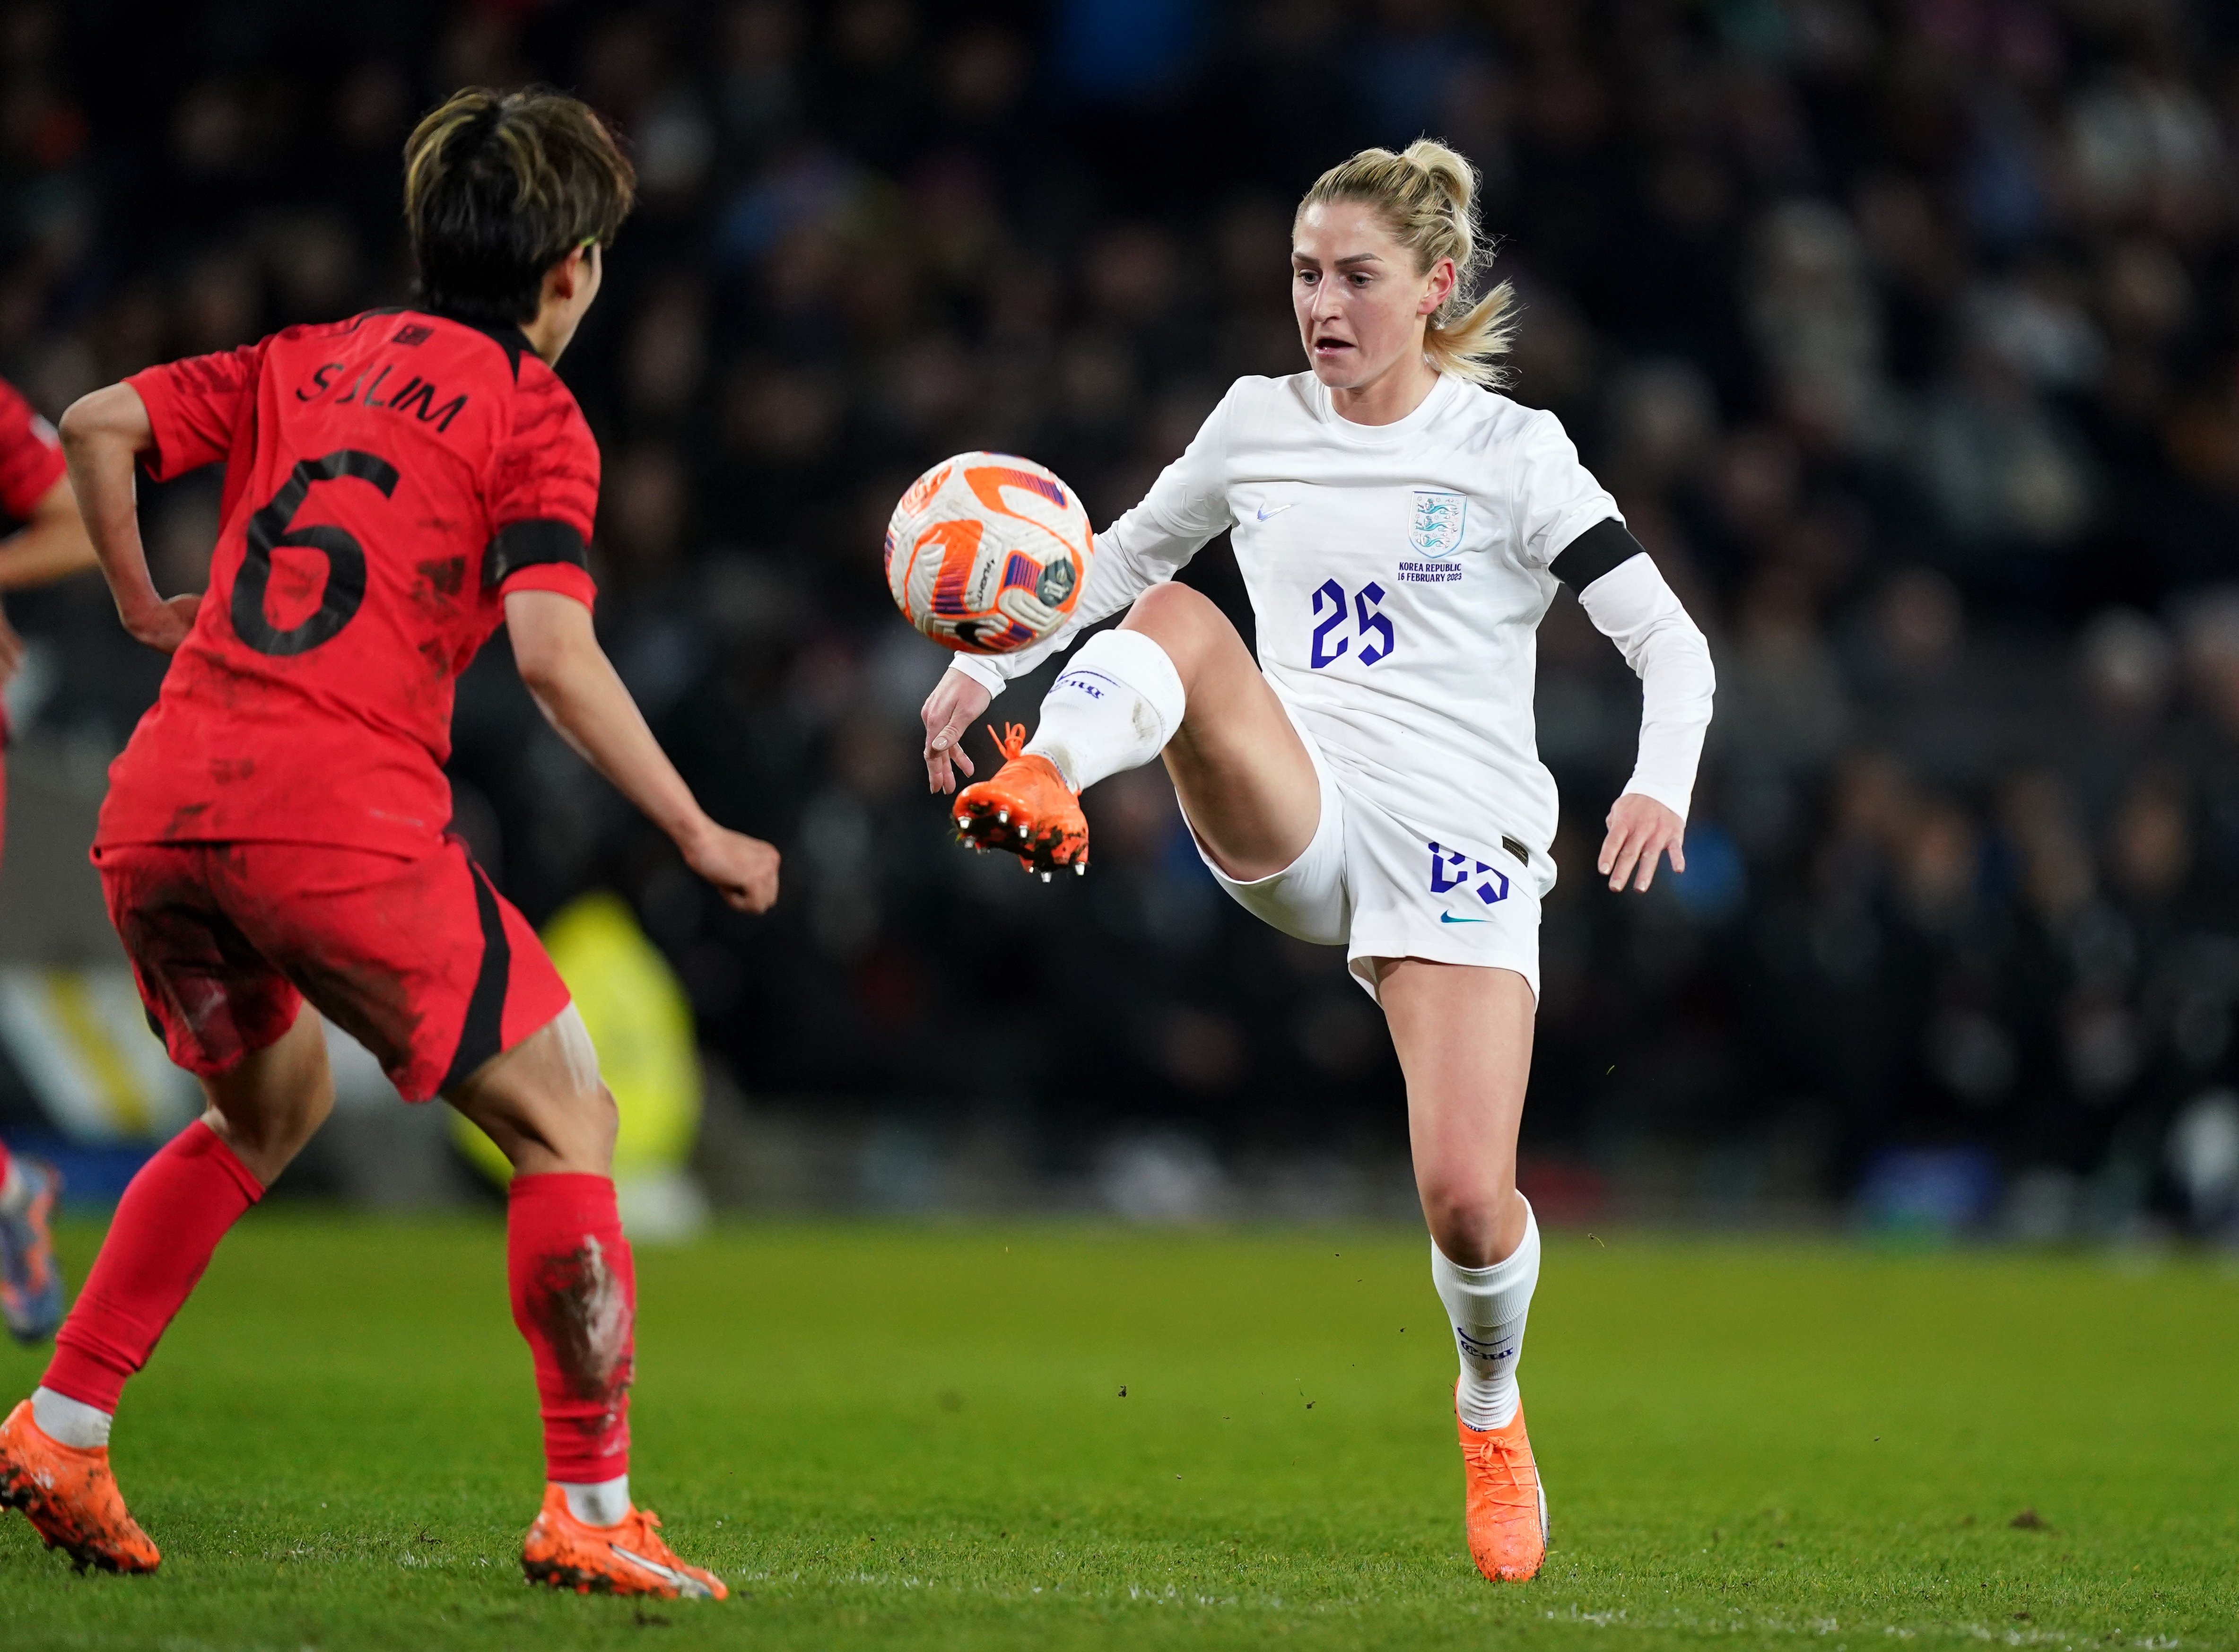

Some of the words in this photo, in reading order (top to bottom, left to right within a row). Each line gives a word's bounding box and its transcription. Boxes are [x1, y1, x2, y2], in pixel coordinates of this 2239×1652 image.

[230, 449, 400, 657] 6
[1397, 573, 1405, 581] 16
[1407, 573, 1446, 582] FEBRUARY
[1447, 572, 1462, 582] 2023
[1399, 562, 1423, 572] KOREA
[1426, 563, 1462, 572] REPUBLIC
[1311, 578, 1394, 669] 25
